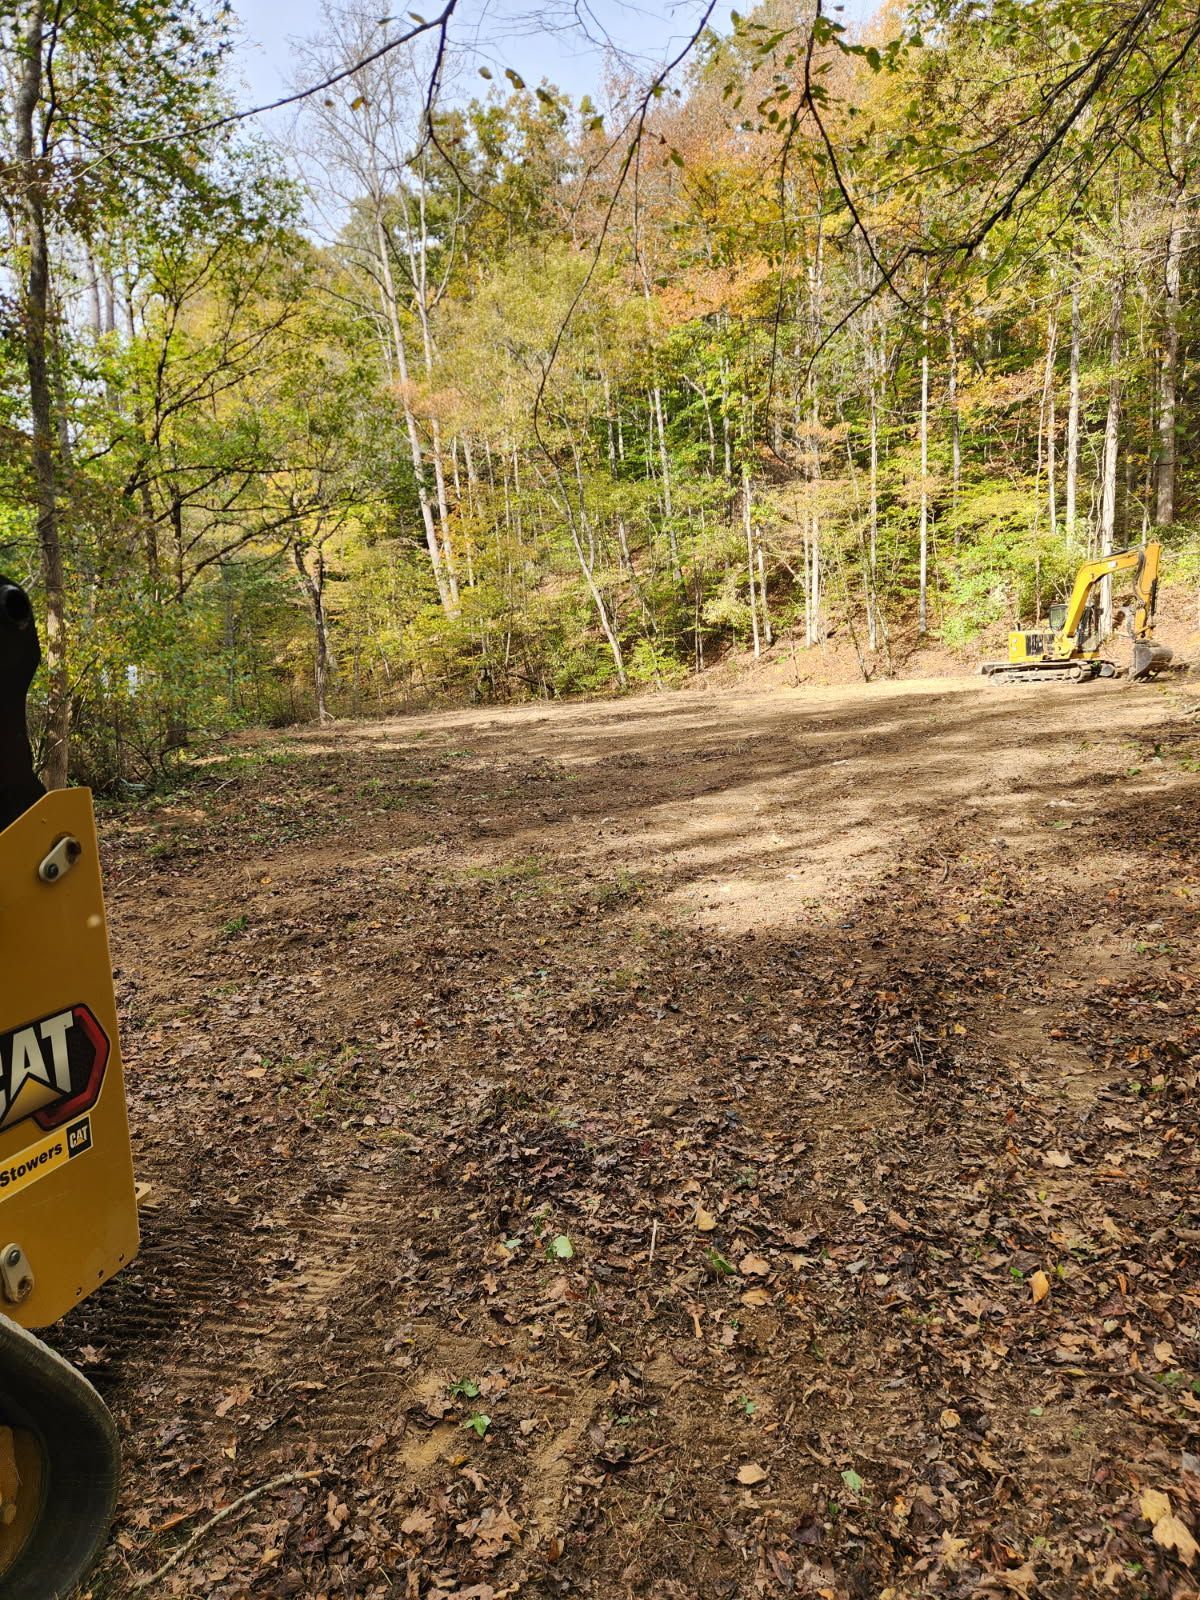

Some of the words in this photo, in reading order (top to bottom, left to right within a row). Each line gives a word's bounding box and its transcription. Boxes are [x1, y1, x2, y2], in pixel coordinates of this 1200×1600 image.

[0, 1010, 73, 1119] AT
[0, 1143, 63, 1188] Stowers
[69, 1125, 88, 1149] CAT
